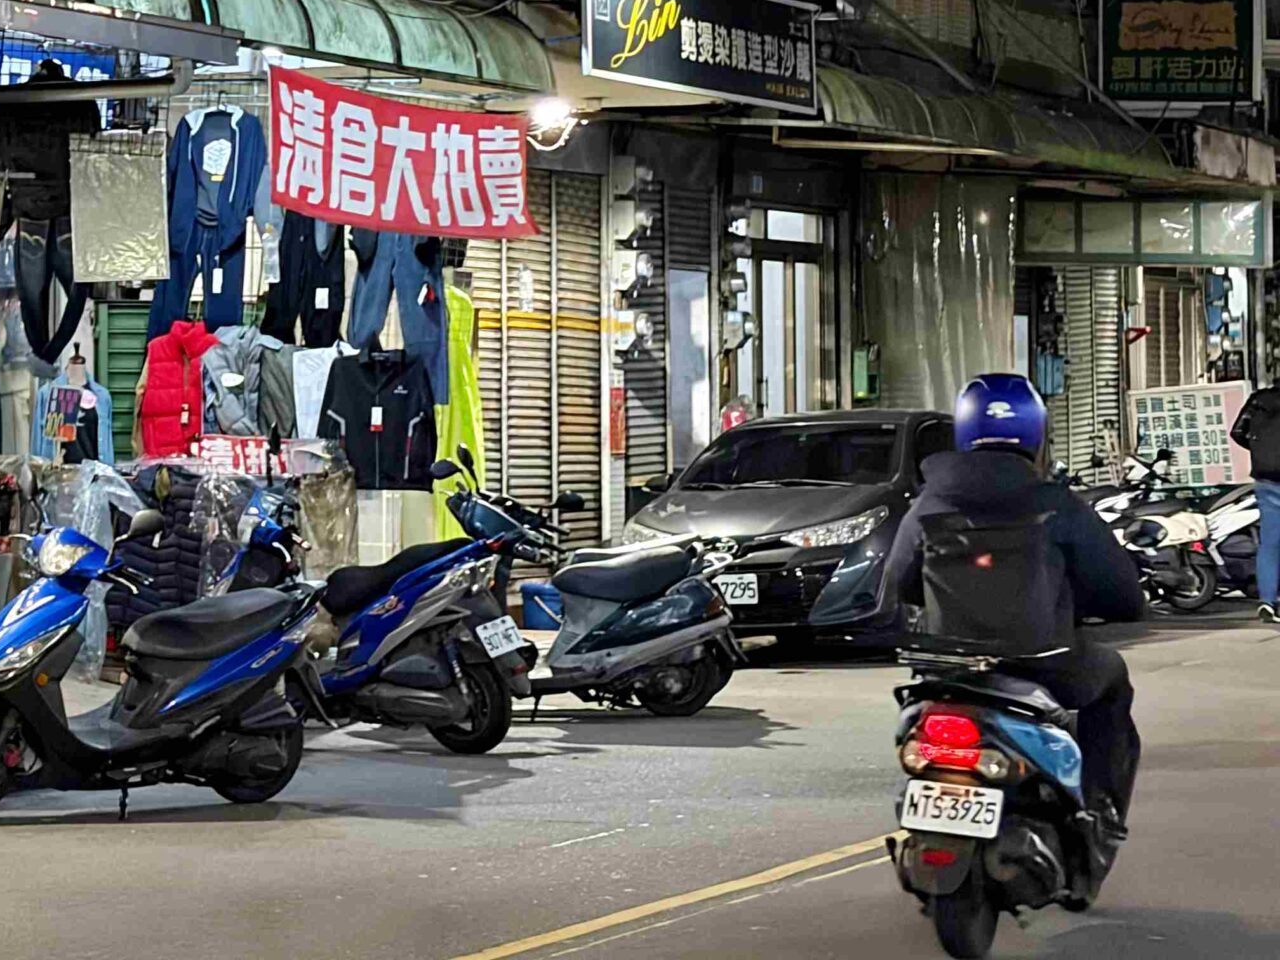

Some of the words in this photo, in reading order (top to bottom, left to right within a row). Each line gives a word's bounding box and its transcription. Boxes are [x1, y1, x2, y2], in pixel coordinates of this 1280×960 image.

[277, 80, 528, 229] 清倉大拍賣
